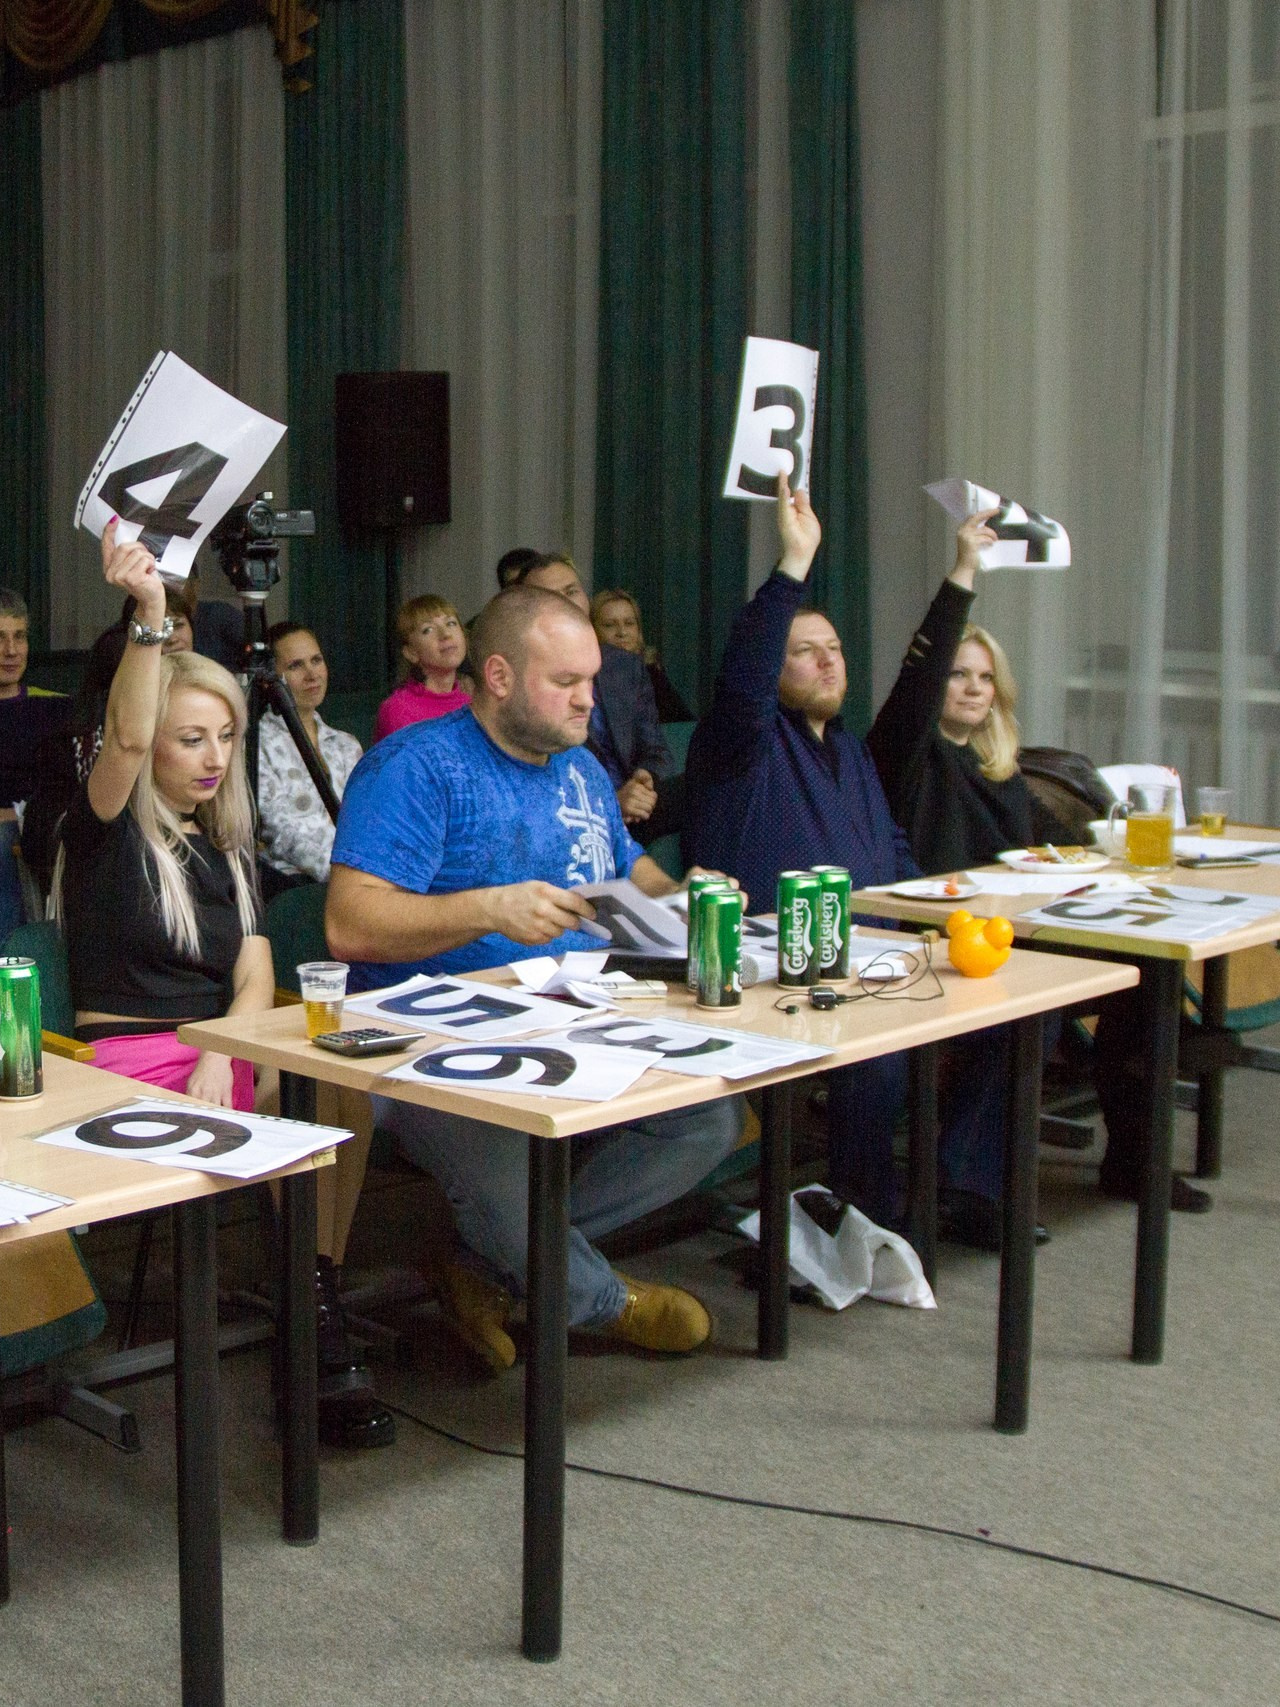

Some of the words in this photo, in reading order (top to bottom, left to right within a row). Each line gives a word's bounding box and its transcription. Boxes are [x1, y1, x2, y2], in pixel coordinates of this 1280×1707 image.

[737, 384, 805, 497] 3
[98, 441, 229, 562] 4
[783, 897, 813, 975] Carlsberg
[1041, 901, 1177, 927] 5
[377, 983, 534, 1028] 5
[567, 1020, 735, 1059] 3
